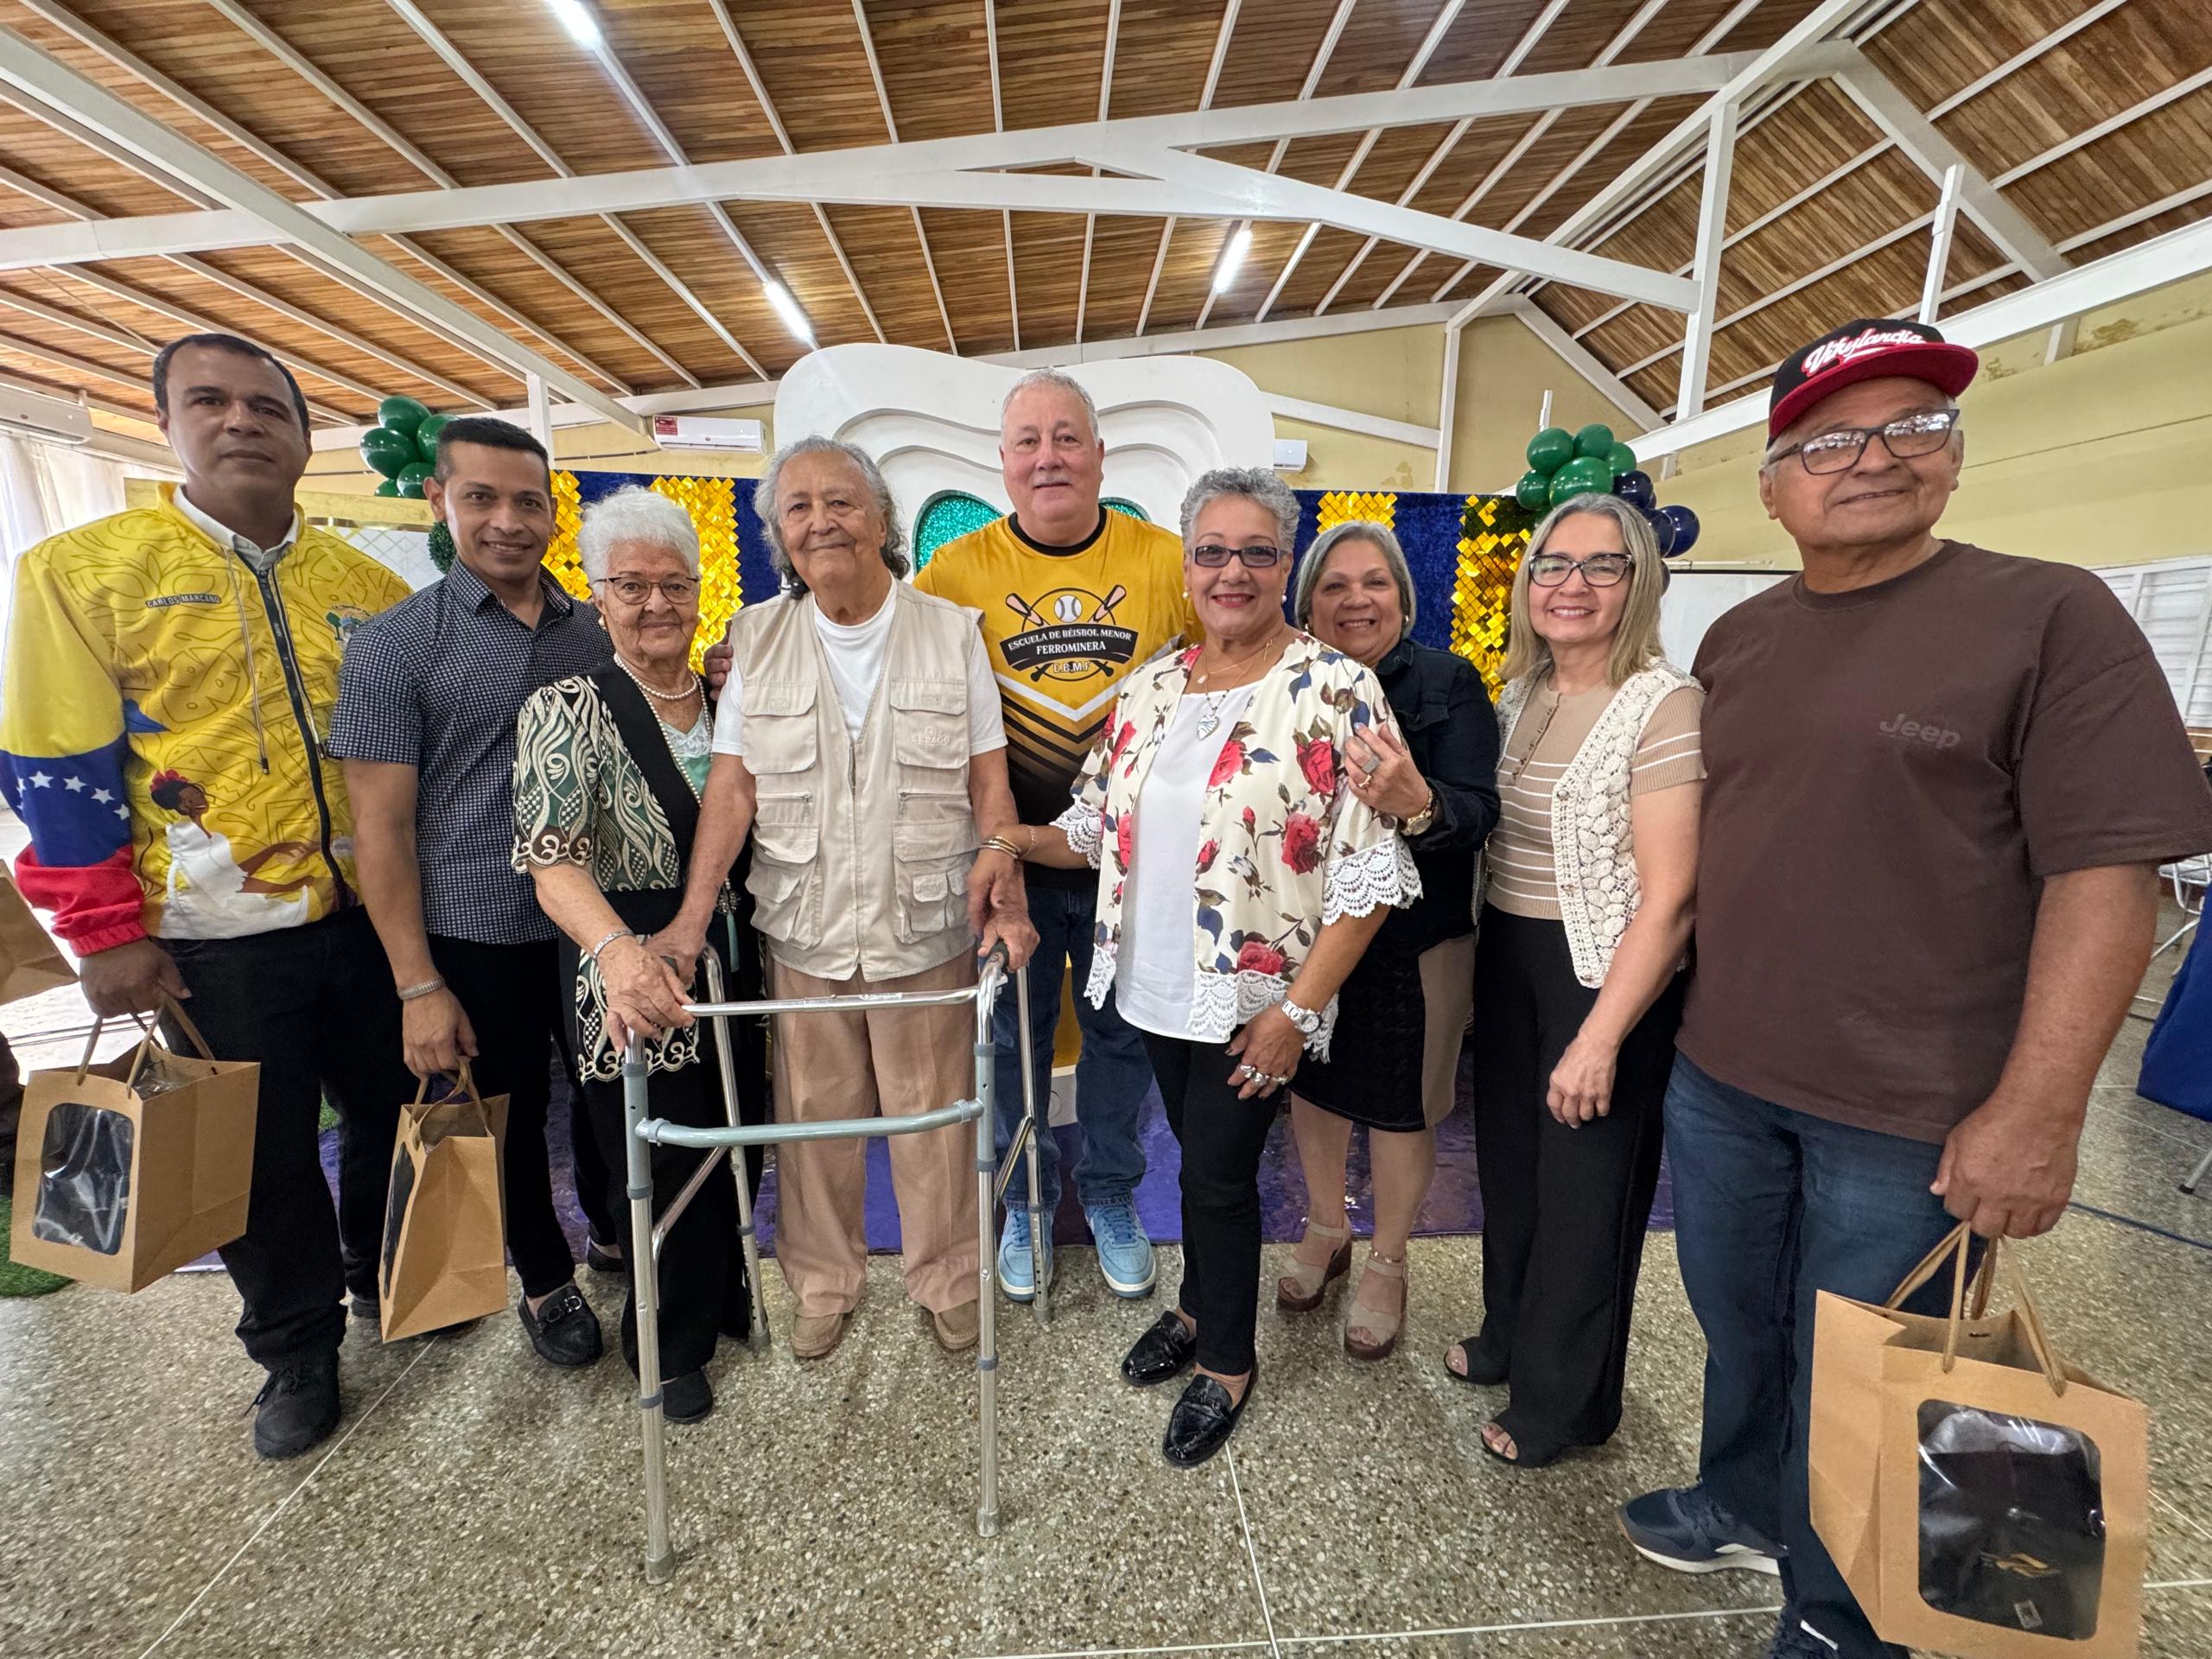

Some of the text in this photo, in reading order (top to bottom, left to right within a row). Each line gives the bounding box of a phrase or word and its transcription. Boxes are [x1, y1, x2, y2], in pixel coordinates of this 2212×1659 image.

[146, 594, 220, 607] CARLOS MARCANO
[1007, 632, 1049, 652] ESCUELA
[1048, 630, 1062, 639] DE
[1100, 628, 1132, 642] MENOR
[1036, 640, 1107, 655] FERROMINERA
[1879, 713, 1961, 749] Jeep
